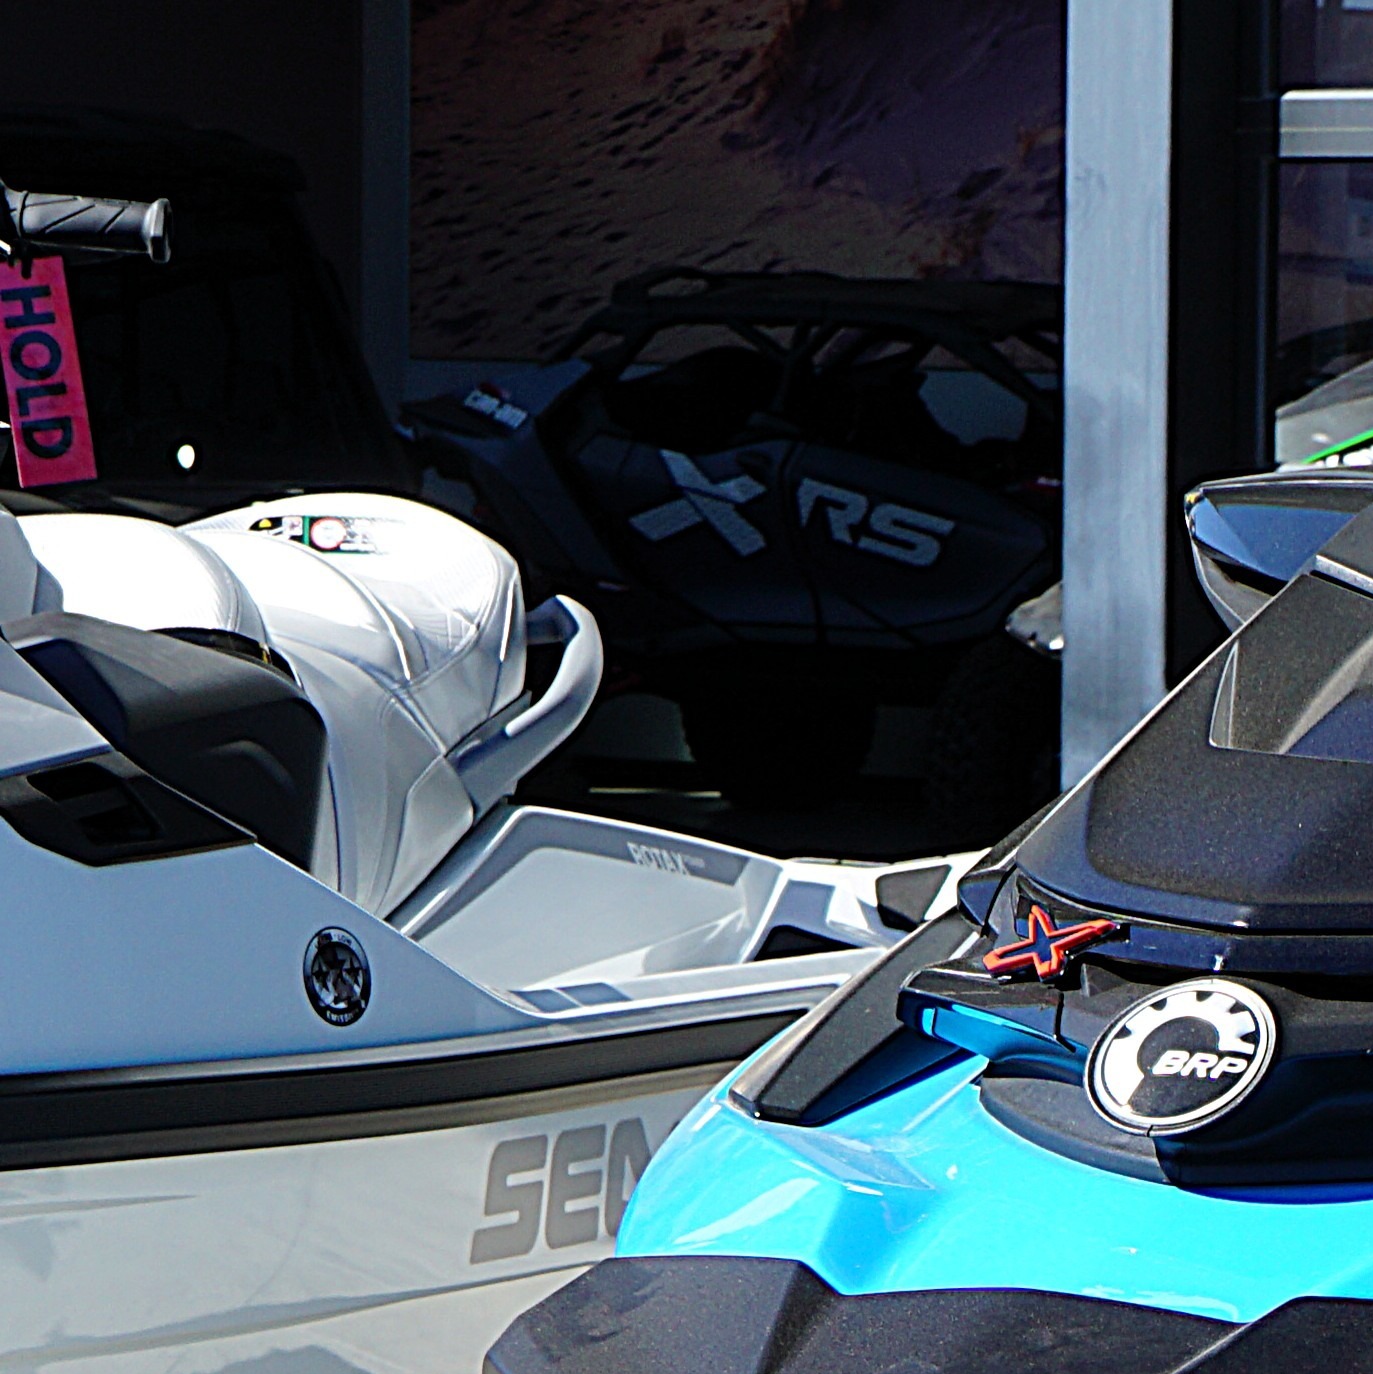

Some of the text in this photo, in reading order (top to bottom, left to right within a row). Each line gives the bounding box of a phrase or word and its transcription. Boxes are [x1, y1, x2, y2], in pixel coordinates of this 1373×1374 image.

[0, 285, 74, 459] HOLD
[798, 478, 956, 568] RS
[1152, 1050, 1248, 1079] BRP
